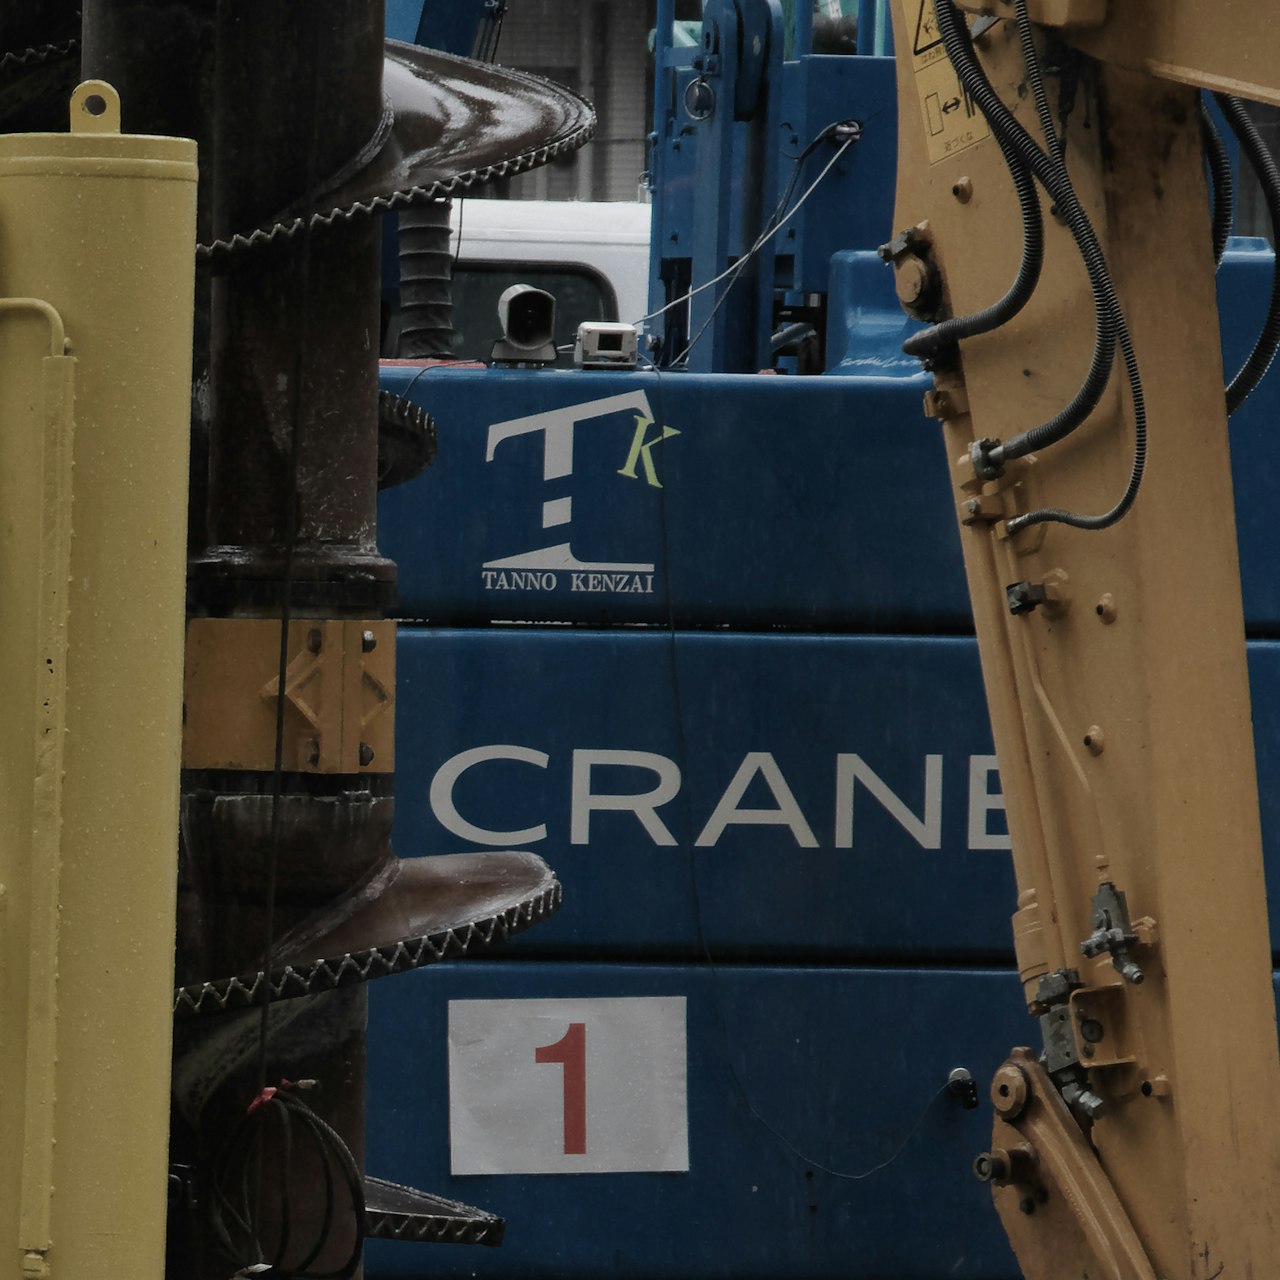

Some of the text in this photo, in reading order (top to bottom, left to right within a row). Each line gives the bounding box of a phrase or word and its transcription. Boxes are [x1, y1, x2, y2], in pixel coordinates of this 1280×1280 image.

[482, 571, 654, 593] TANNO KENZAI
[429, 744, 1013, 850] CRANE
[534, 1022, 588, 1156] 1
